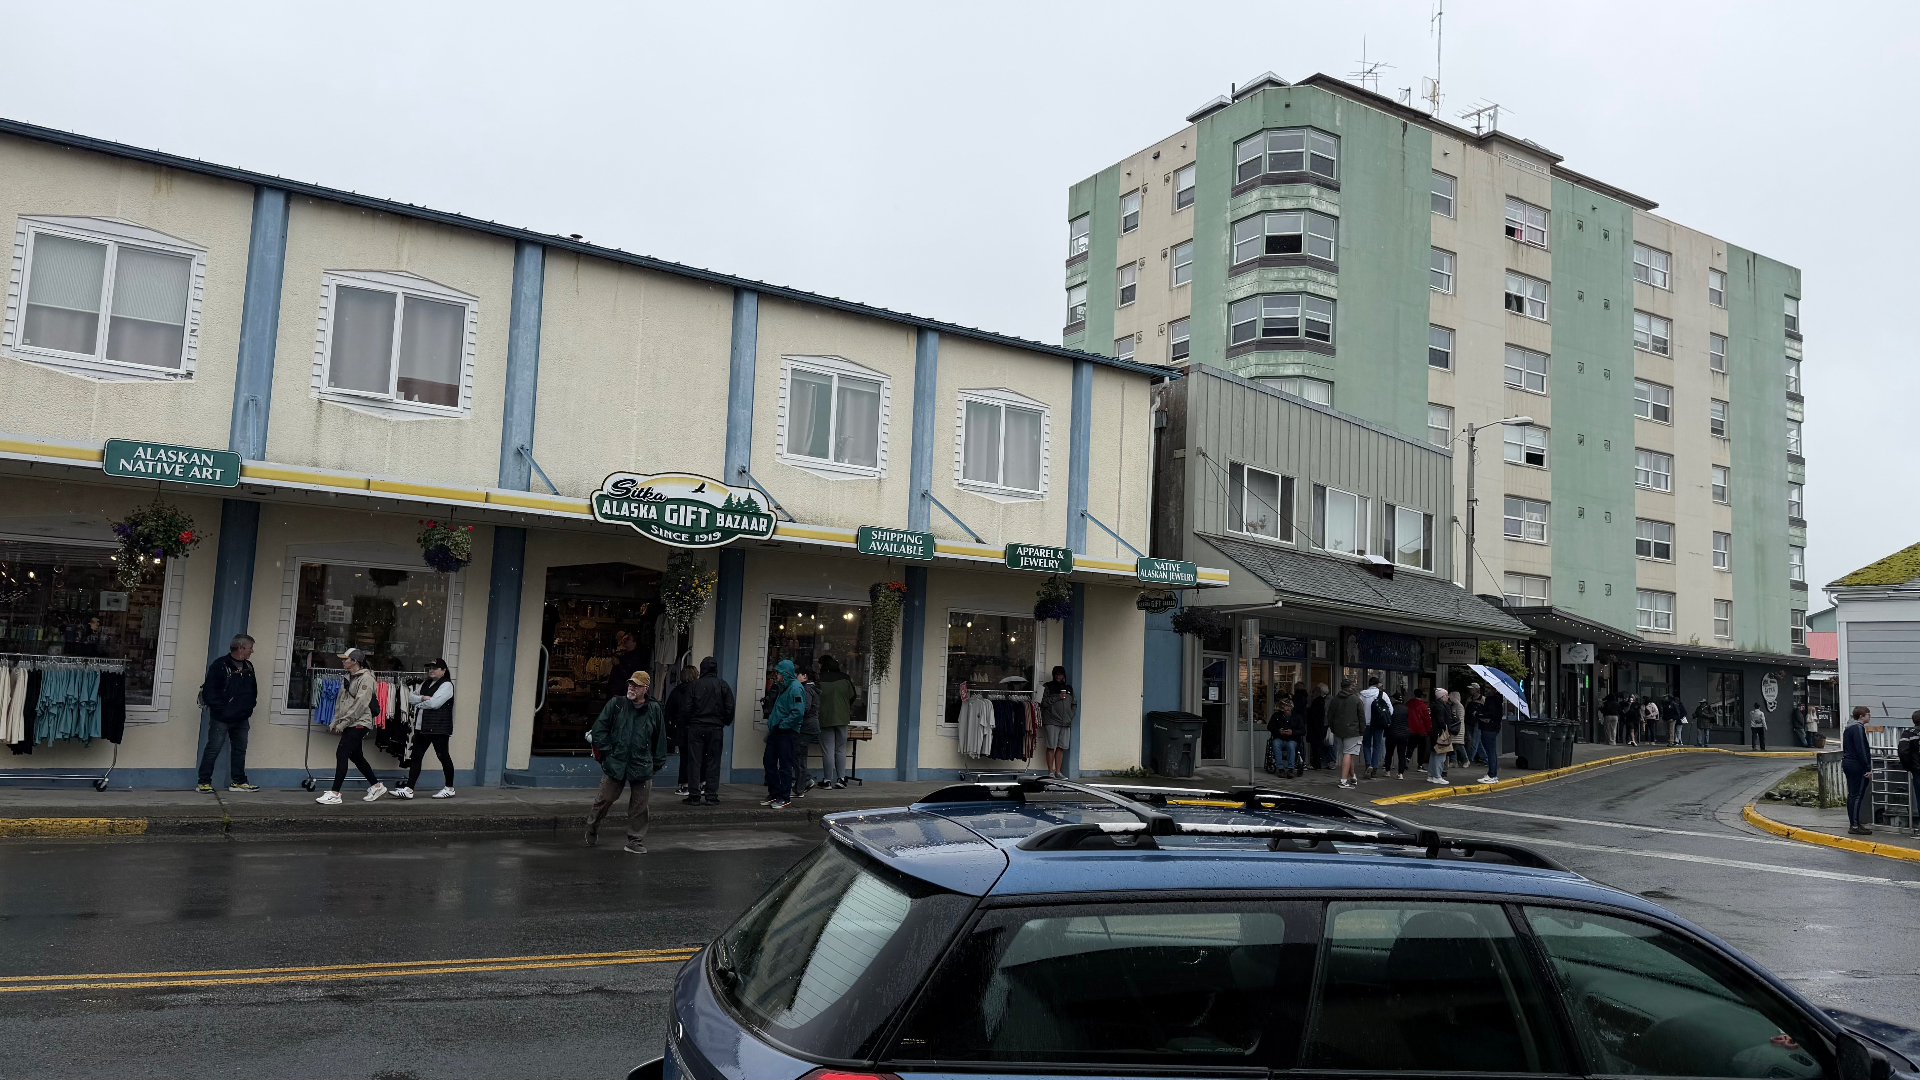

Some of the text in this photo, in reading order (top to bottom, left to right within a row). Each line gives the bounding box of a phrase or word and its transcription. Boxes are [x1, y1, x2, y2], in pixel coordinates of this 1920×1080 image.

[133, 446, 214, 466] ALASKAN
[119, 459, 224, 480] NATIVE ART
[608, 478, 668, 502] Sitka
[601, 499, 768, 532] ALASKA GIFT BAZAAR
[650, 524, 722, 543] SINCE 1919
[871, 530, 923, 545] SHIPPING
[868, 541, 924, 556] AVAILABLE
[1016, 546, 1065, 559] APPAREL &
[1019, 556, 1060, 569] JEWELRY
[1154, 561, 1181, 572] NATIVE
[1140, 569, 1195, 582] ALASKAN JEWELRY
